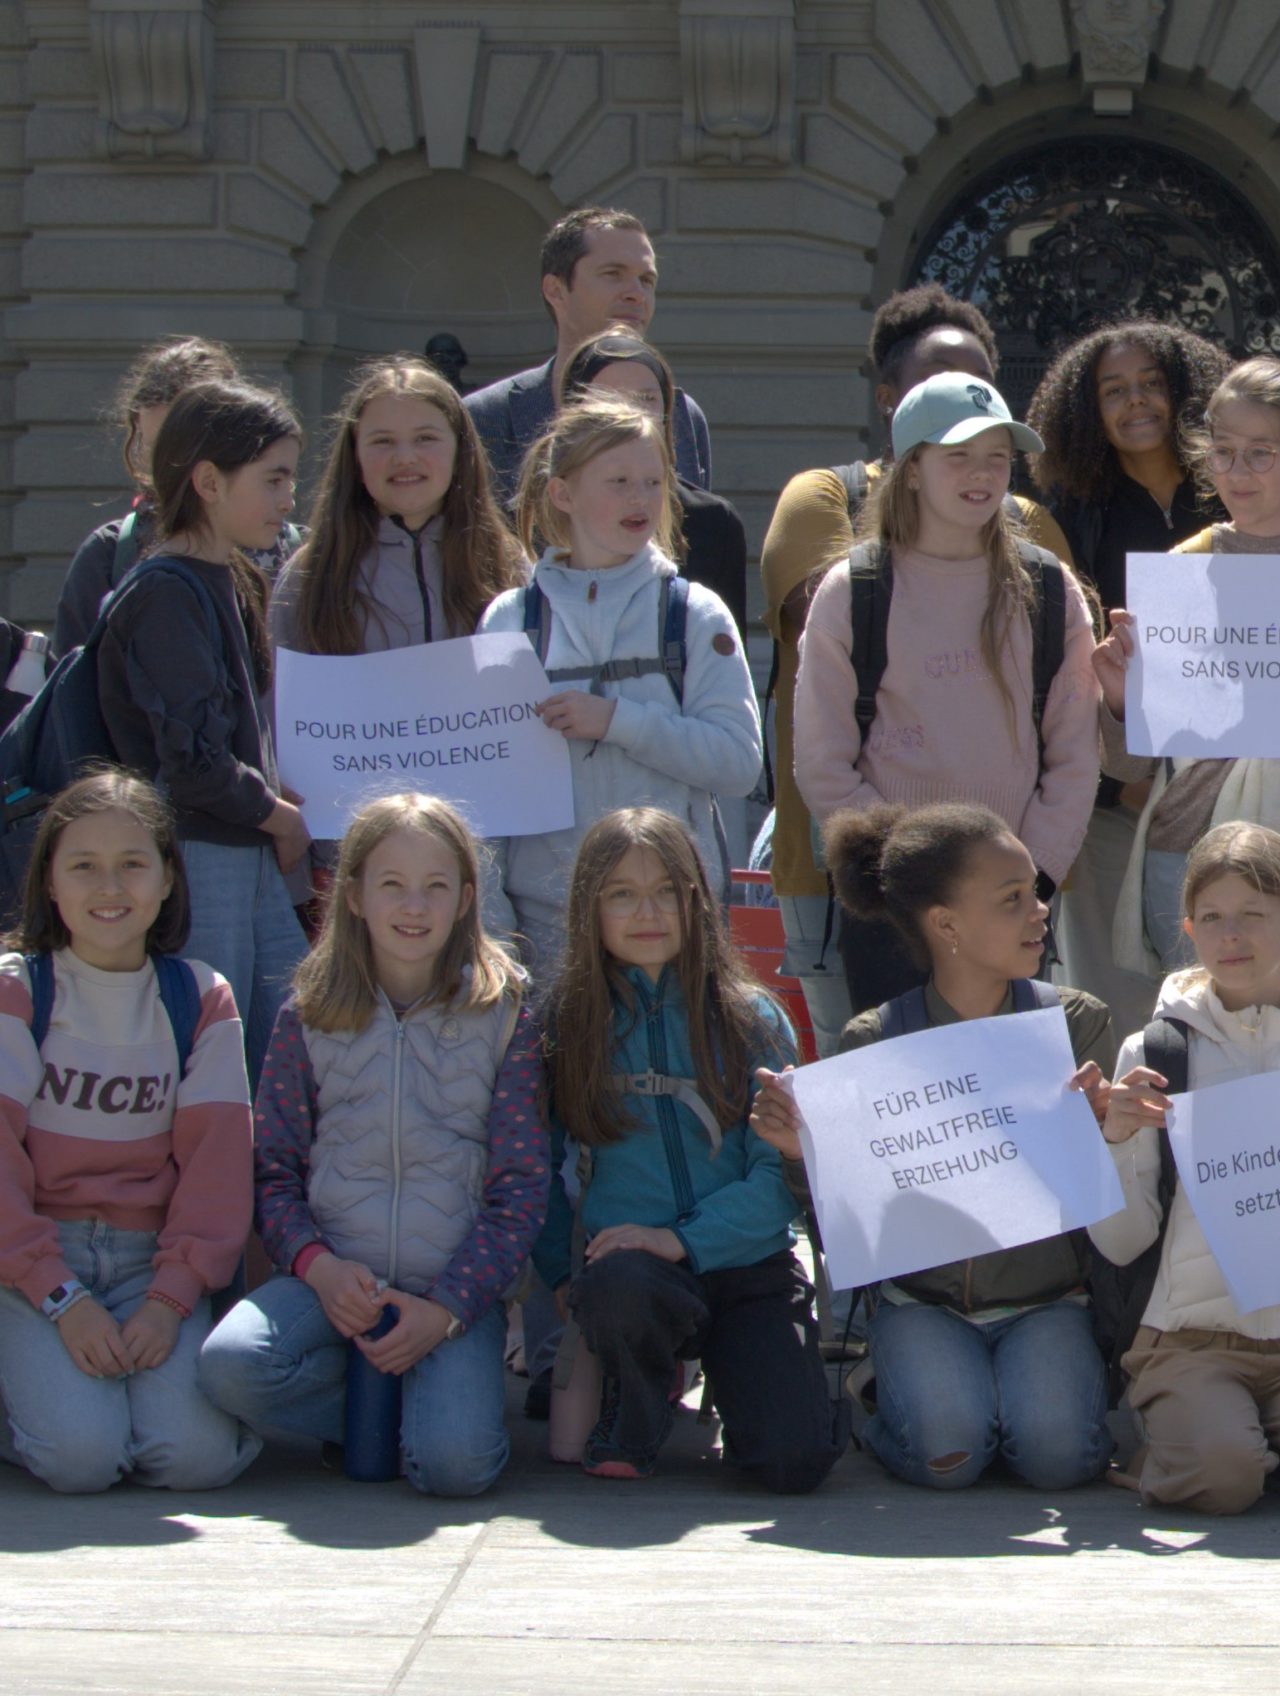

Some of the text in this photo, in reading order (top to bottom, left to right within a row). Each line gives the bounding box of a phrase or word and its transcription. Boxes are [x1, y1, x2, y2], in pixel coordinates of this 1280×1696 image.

[1146, 626, 1207, 645] POUR
[1213, 626, 1258, 645] UNE
[1182, 661, 1239, 679] SANS
[295, 700, 540, 741] POUR UNE ÉDUCATION
[333, 741, 510, 772] SANS VIOLENCE
[35, 1062, 171, 1115] NICE!
[873, 1073, 982, 1120] FÜR EINE
[869, 1105, 1017, 1158] GEWALTFREIE
[892, 1140, 1018, 1190] ERZIEHUNG
[1196, 1158, 1228, 1184] Die
